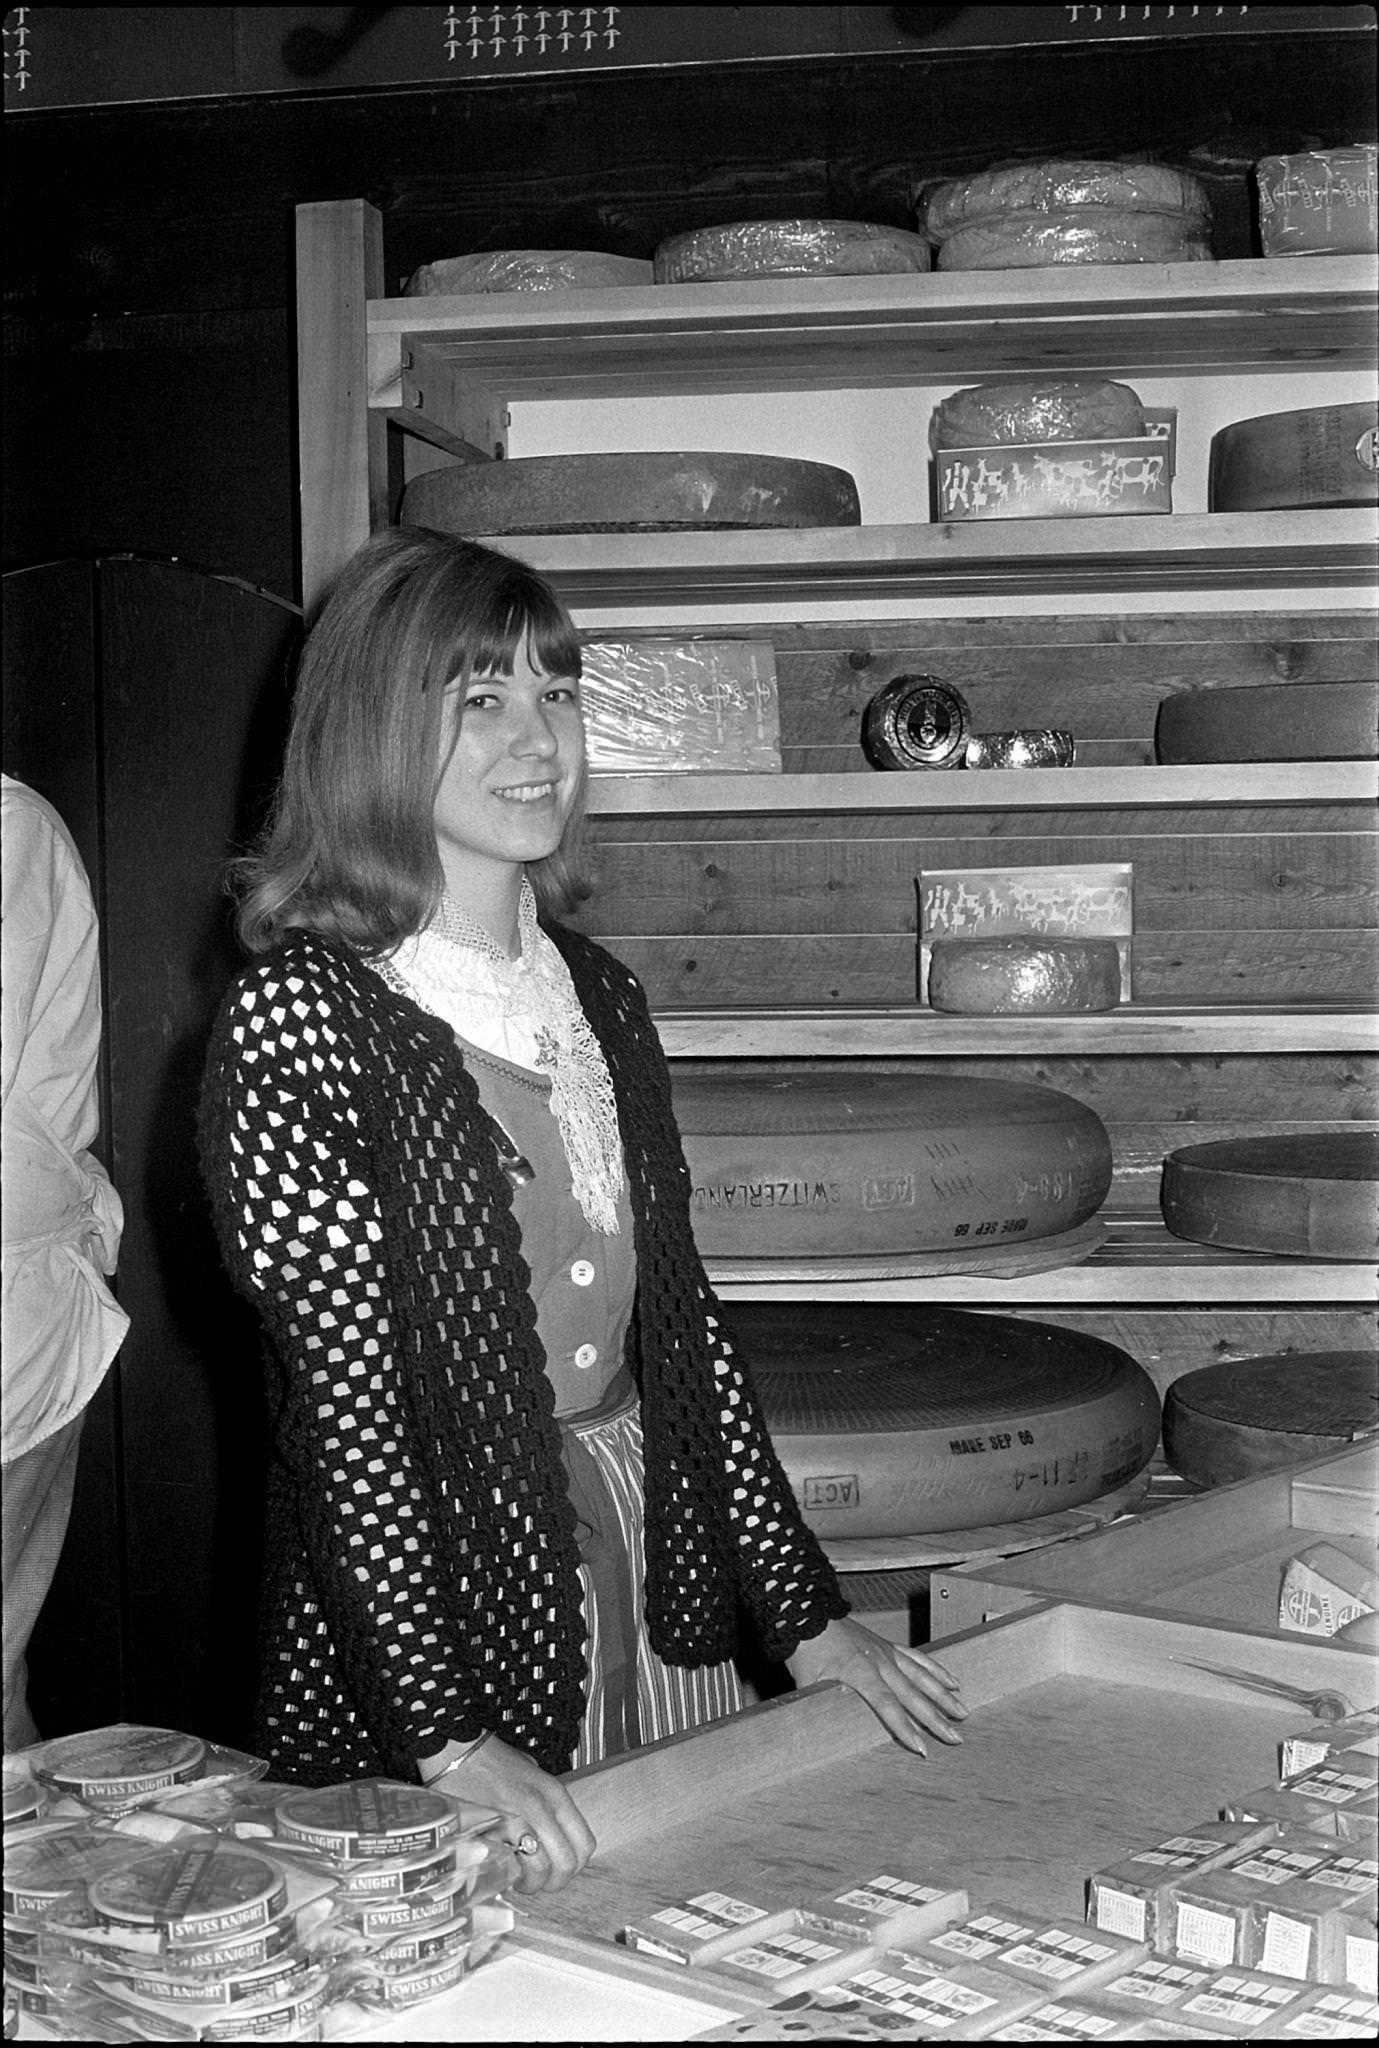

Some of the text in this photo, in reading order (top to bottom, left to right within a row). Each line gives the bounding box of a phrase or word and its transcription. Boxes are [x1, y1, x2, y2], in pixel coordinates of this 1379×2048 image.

[695, 1183, 841, 1211] SWITZERLAND
[975, 1221, 999, 1236] SEP
[988, 1433, 1012, 1450] SEP
[810, 1482, 853, 1505] ACT
[1321, 1597, 1334, 1635] GENUINE
[86, 1776, 170, 1797] SWISS KNIGHT
[300, 1832, 342, 1850] KNIGHT
[348, 1875, 397, 1891] KNIGHT
[174, 1904, 264, 1937] SWISS KNIGHT
[369, 1898, 450, 1926] SWISS KNIGHT
[214, 1943, 262, 1965] KNIGHT
[172, 1984, 223, 1999] KNIGHT
[390, 1978, 430, 1997] SWISS
